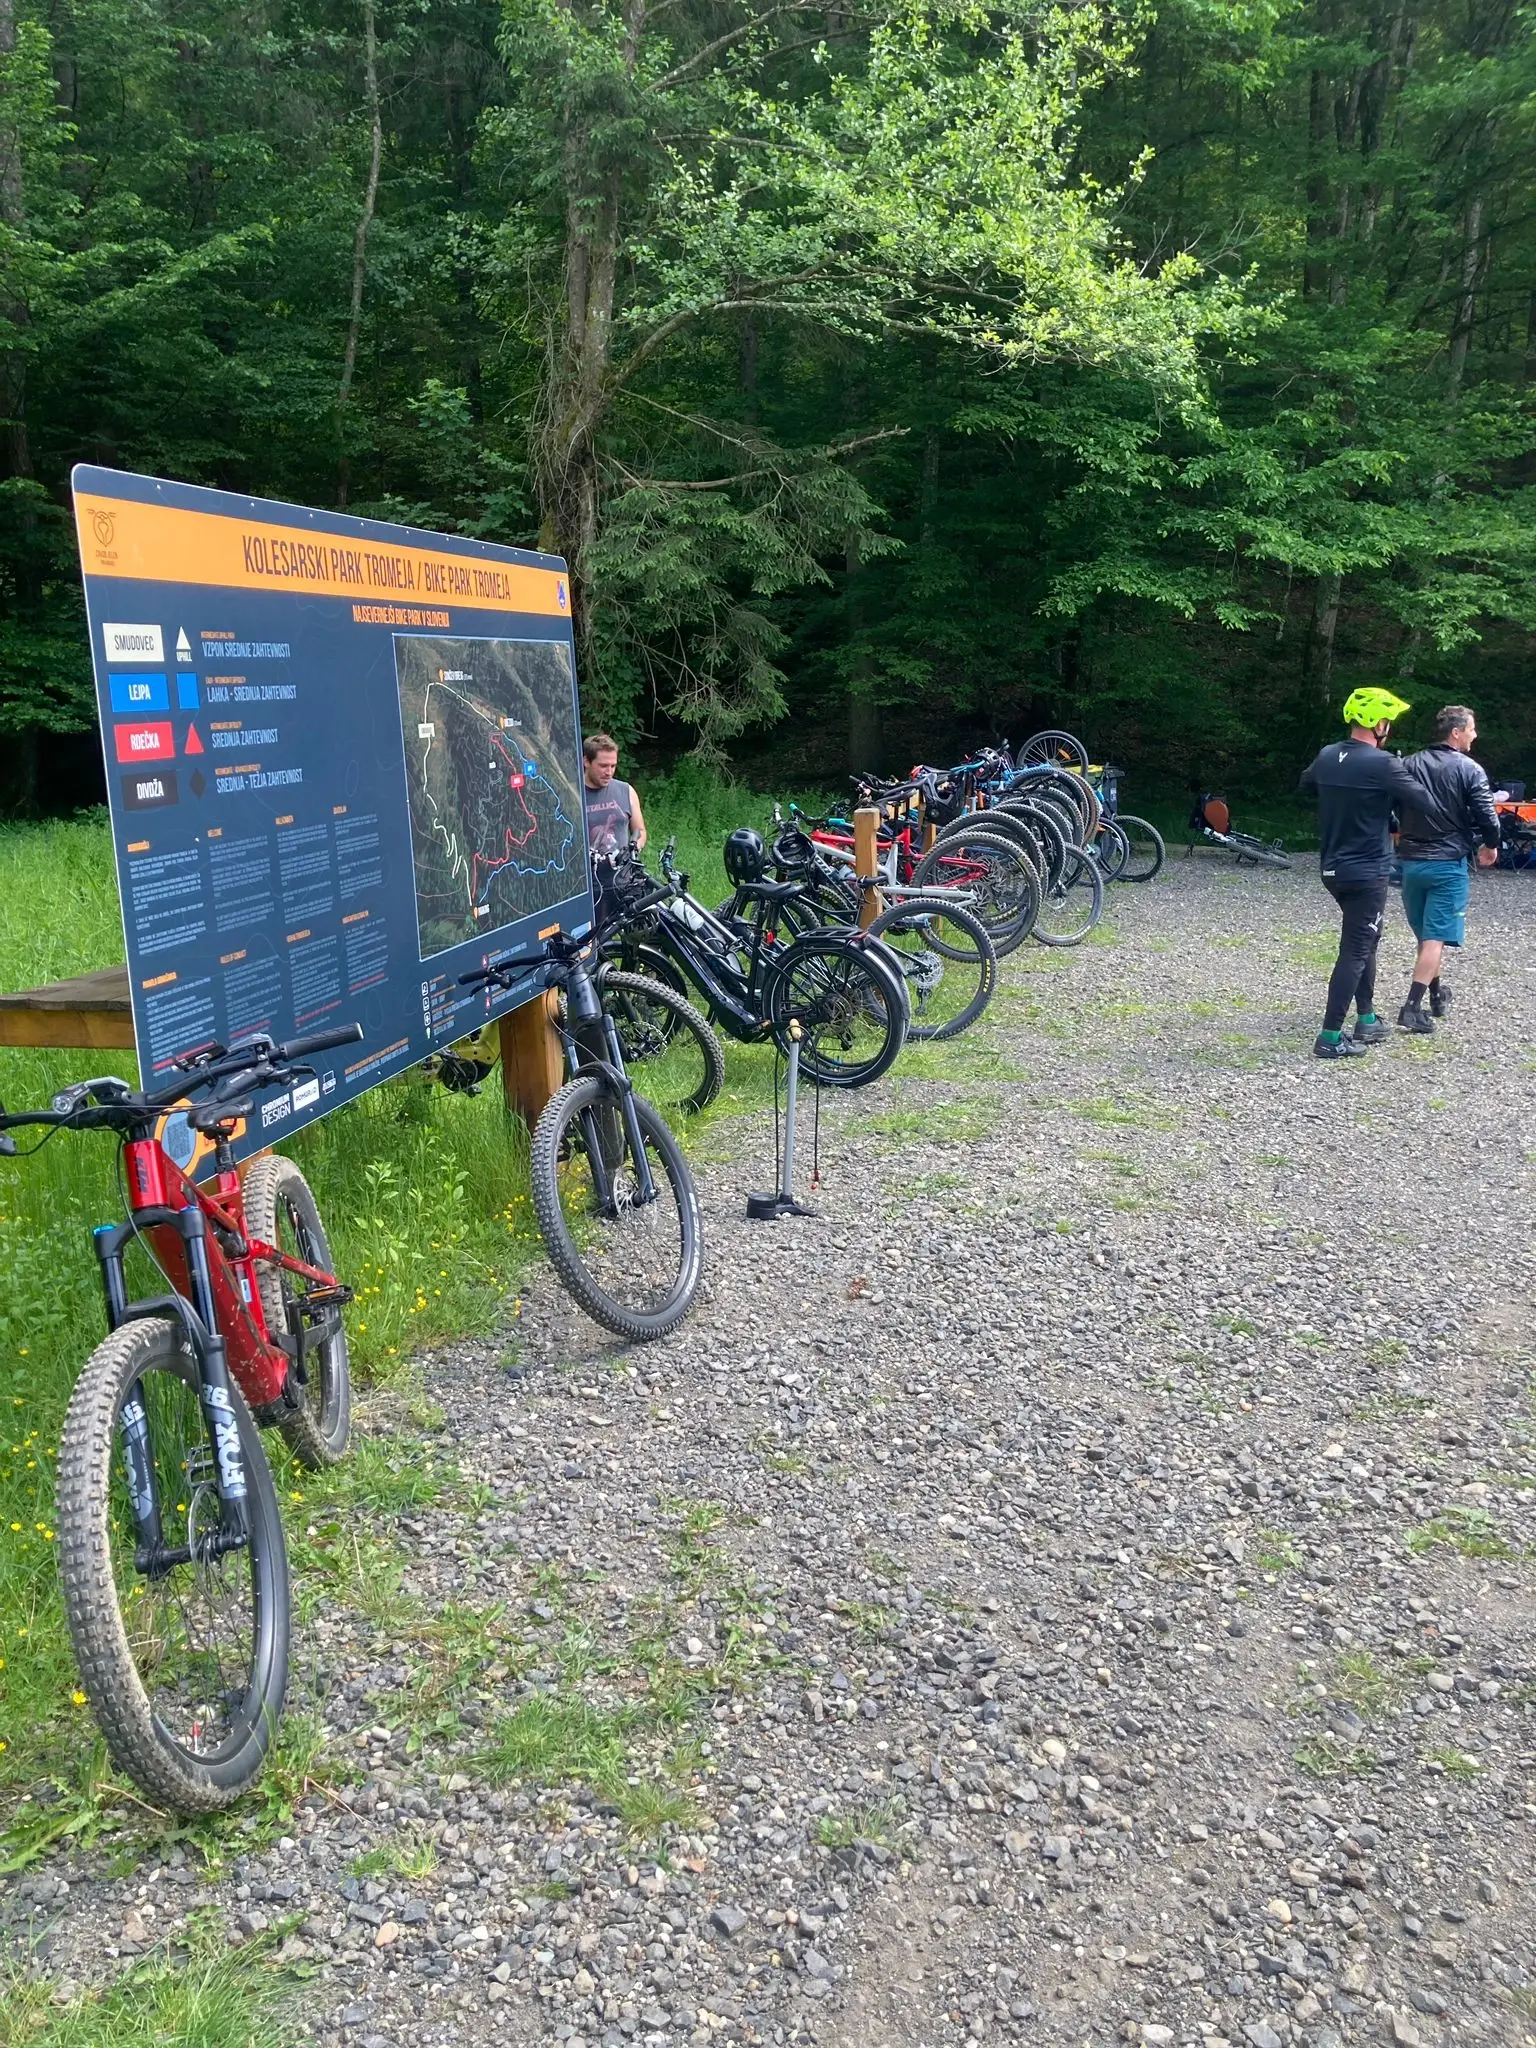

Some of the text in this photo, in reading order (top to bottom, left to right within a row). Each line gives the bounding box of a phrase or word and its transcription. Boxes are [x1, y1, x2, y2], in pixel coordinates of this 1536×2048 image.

[242, 535, 511, 600] KOLESARSKI PARK TROMEJA / BIKE PARK TROMEJA
[408, 608, 422, 625] PARK
[114, 634, 154, 651] SMUDOVEC
[201, 641, 290, 658] VZPON SREDNJE ZAHTEVNOSTI
[128, 684, 151, 701] LEJPA
[206, 686, 229, 703] LAHKA
[233, 685, 261, 702] SREDNJA
[259, 685, 297, 701] ZAHTEVNOST
[130, 730, 160, 751] RDEČKA
[211, 728, 278, 749] SREDNJA ZAHTEVNOST
[216, 775, 245, 794] SREDNJA
[249, 771, 268, 789] TEŽJA
[266, 768, 303, 787] ZAHTEVNOST
[262, 1101, 291, 1128] DESIGN
[215, 1420, 246, 1488] FOX
